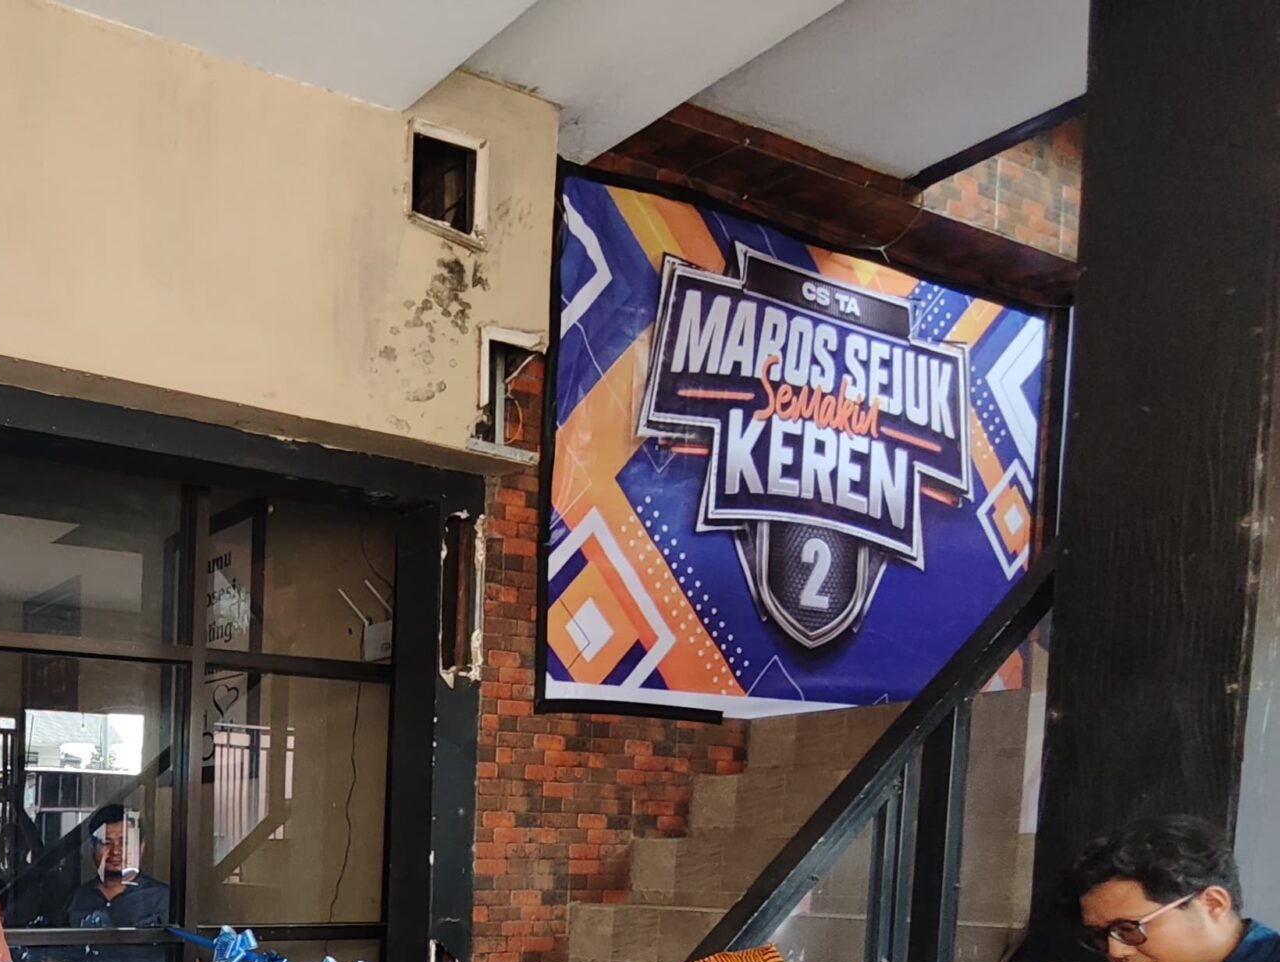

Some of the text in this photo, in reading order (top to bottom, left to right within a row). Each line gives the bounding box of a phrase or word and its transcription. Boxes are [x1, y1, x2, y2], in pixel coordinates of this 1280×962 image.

[802, 282, 860, 316] CS TA
[671, 290, 955, 439] MAROS SEJUK
[725, 408, 908, 529] KEREN
[800, 538, 831, 609] 2
